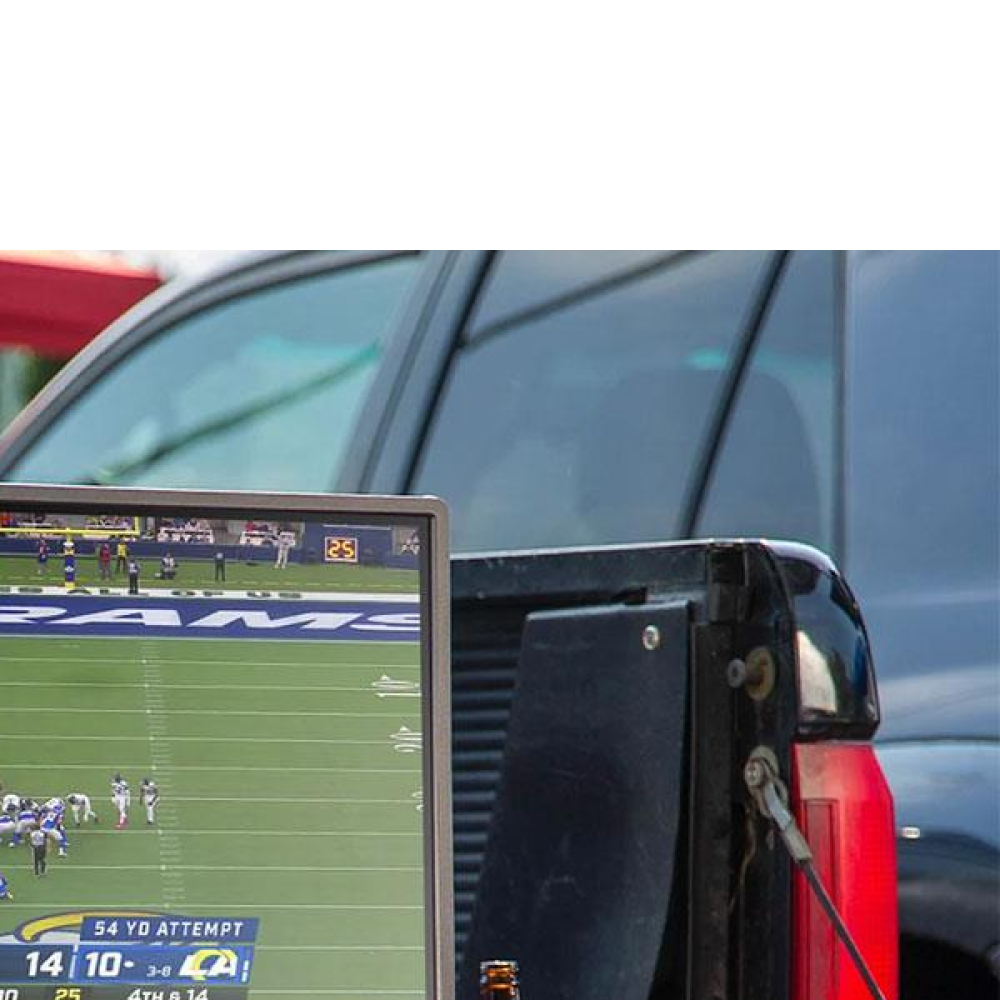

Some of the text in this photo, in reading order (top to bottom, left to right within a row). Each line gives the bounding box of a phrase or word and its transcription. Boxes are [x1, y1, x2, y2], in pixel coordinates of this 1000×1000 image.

[328, 540, 355, 558] 25
[94, 921, 245, 938] 54 YD ATTEMPT
[26, 951, 64, 978] 14
[85, 951, 122, 978] 10
